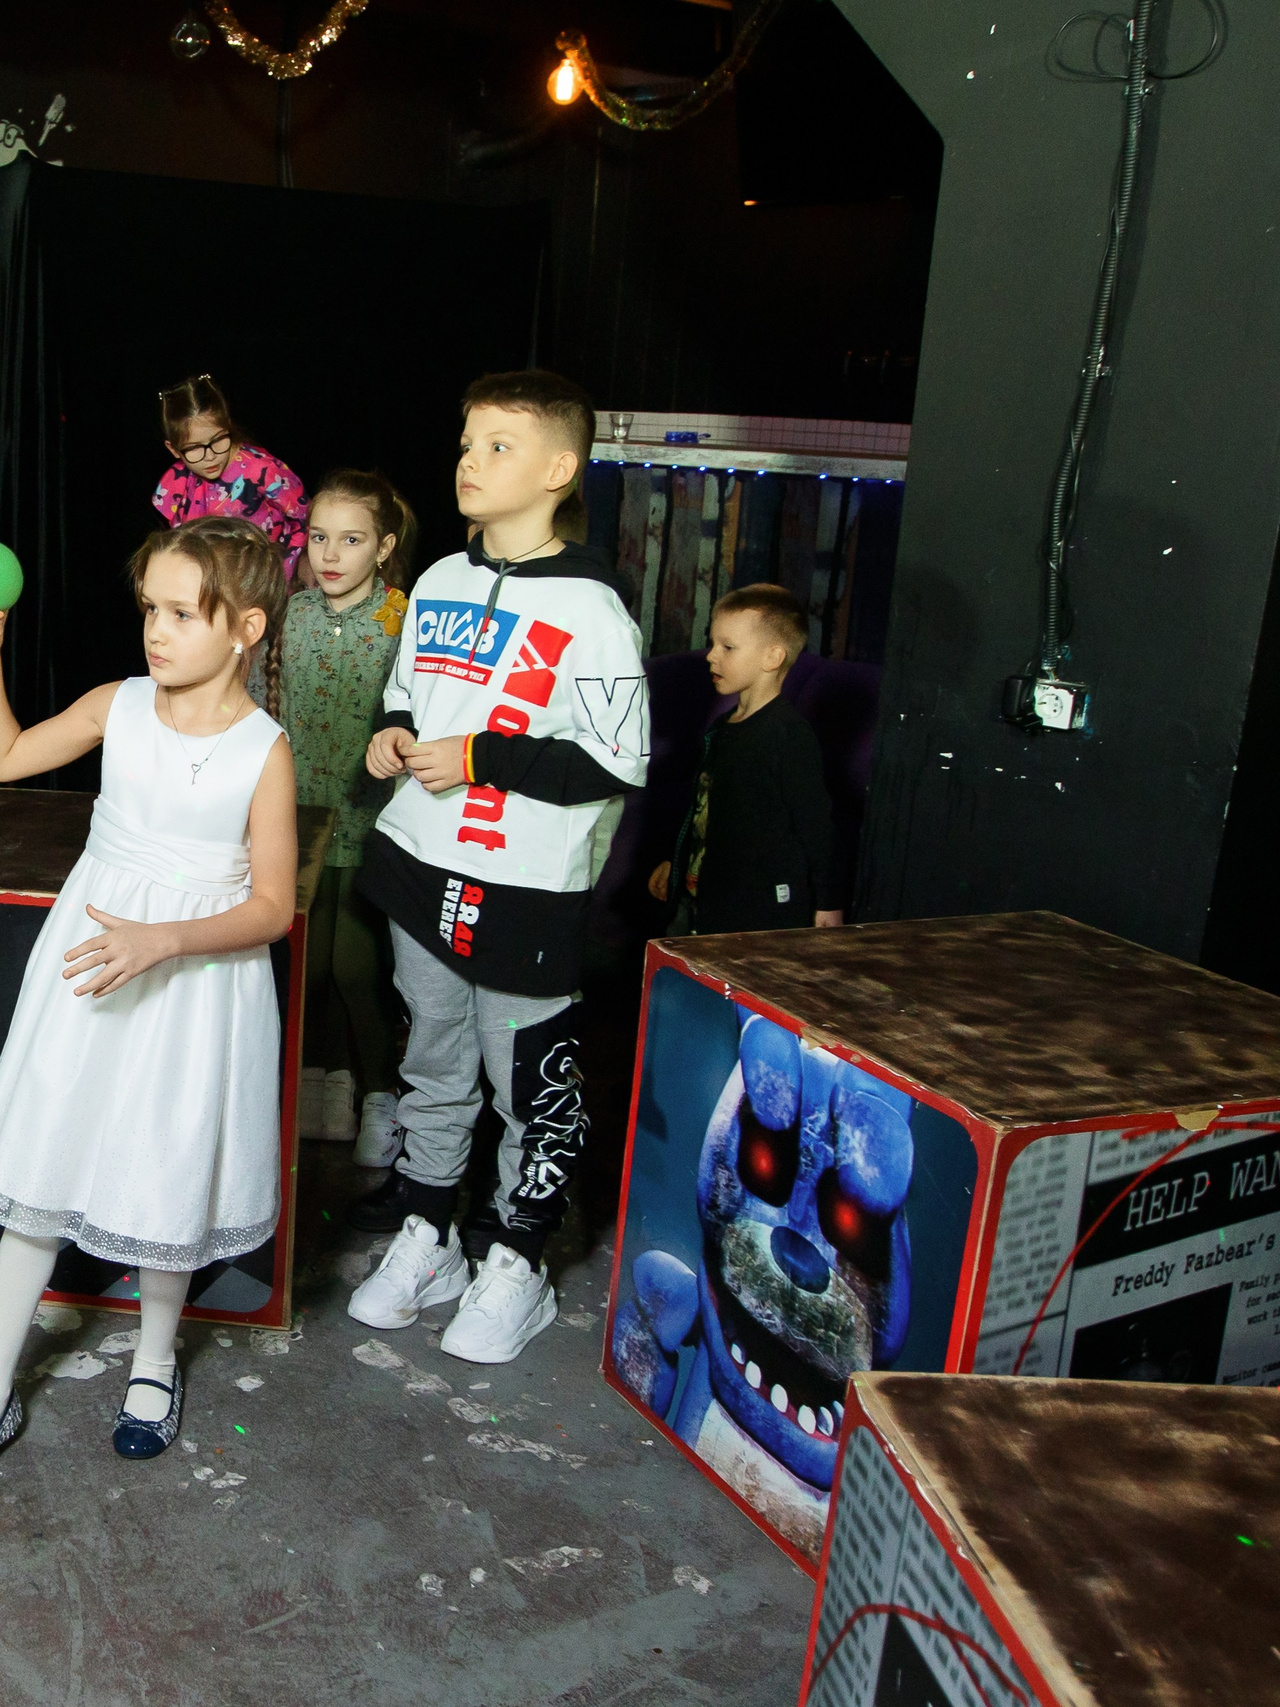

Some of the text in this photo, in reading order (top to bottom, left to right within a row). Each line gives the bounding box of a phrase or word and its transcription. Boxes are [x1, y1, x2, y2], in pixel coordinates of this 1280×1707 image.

[445, 664, 468, 678] CAMP
[1123, 1171, 1210, 1231] HELP
[1112, 1233, 1276, 1297] Freddy Fazbear's
